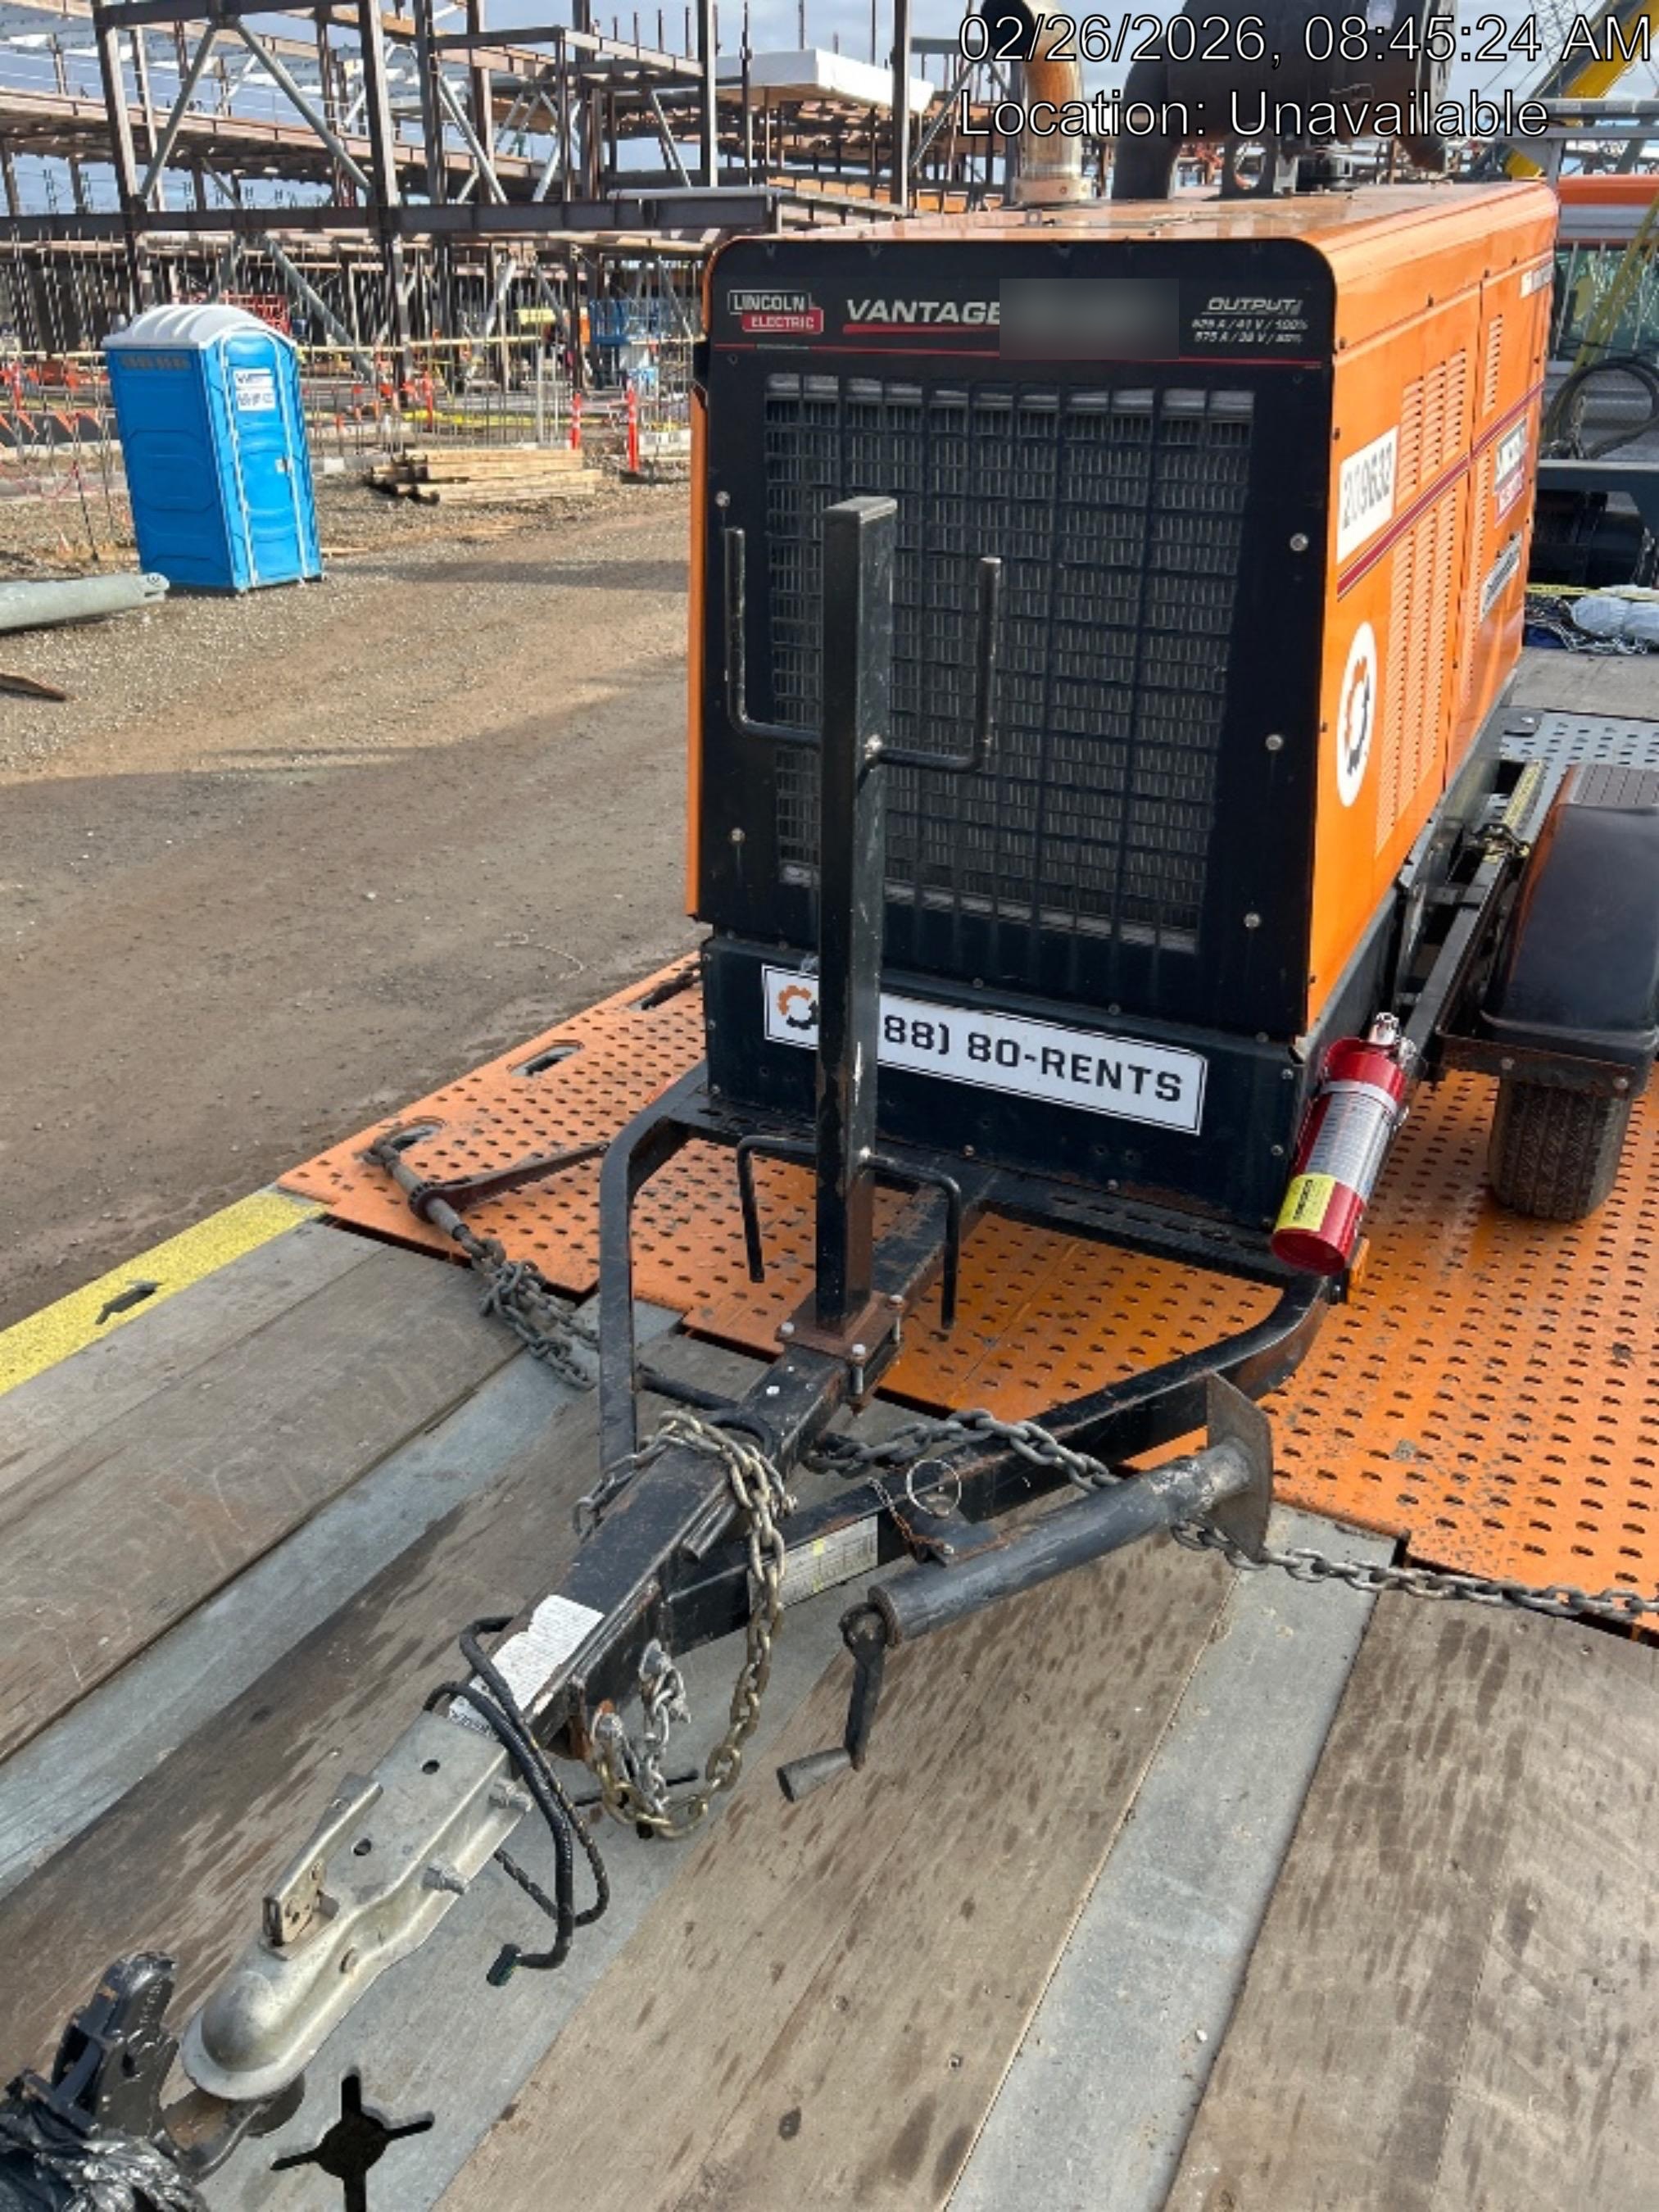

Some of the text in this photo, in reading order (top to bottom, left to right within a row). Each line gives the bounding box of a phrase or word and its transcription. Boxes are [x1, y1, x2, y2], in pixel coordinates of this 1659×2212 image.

[733, 294, 805, 312] LINCOLN
[1208, 297, 1296, 311] OUTPUT
[751, 316, 814, 329] ELECTRIC
[884, 1014, 1182, 1103] 88) 80-RENTS
